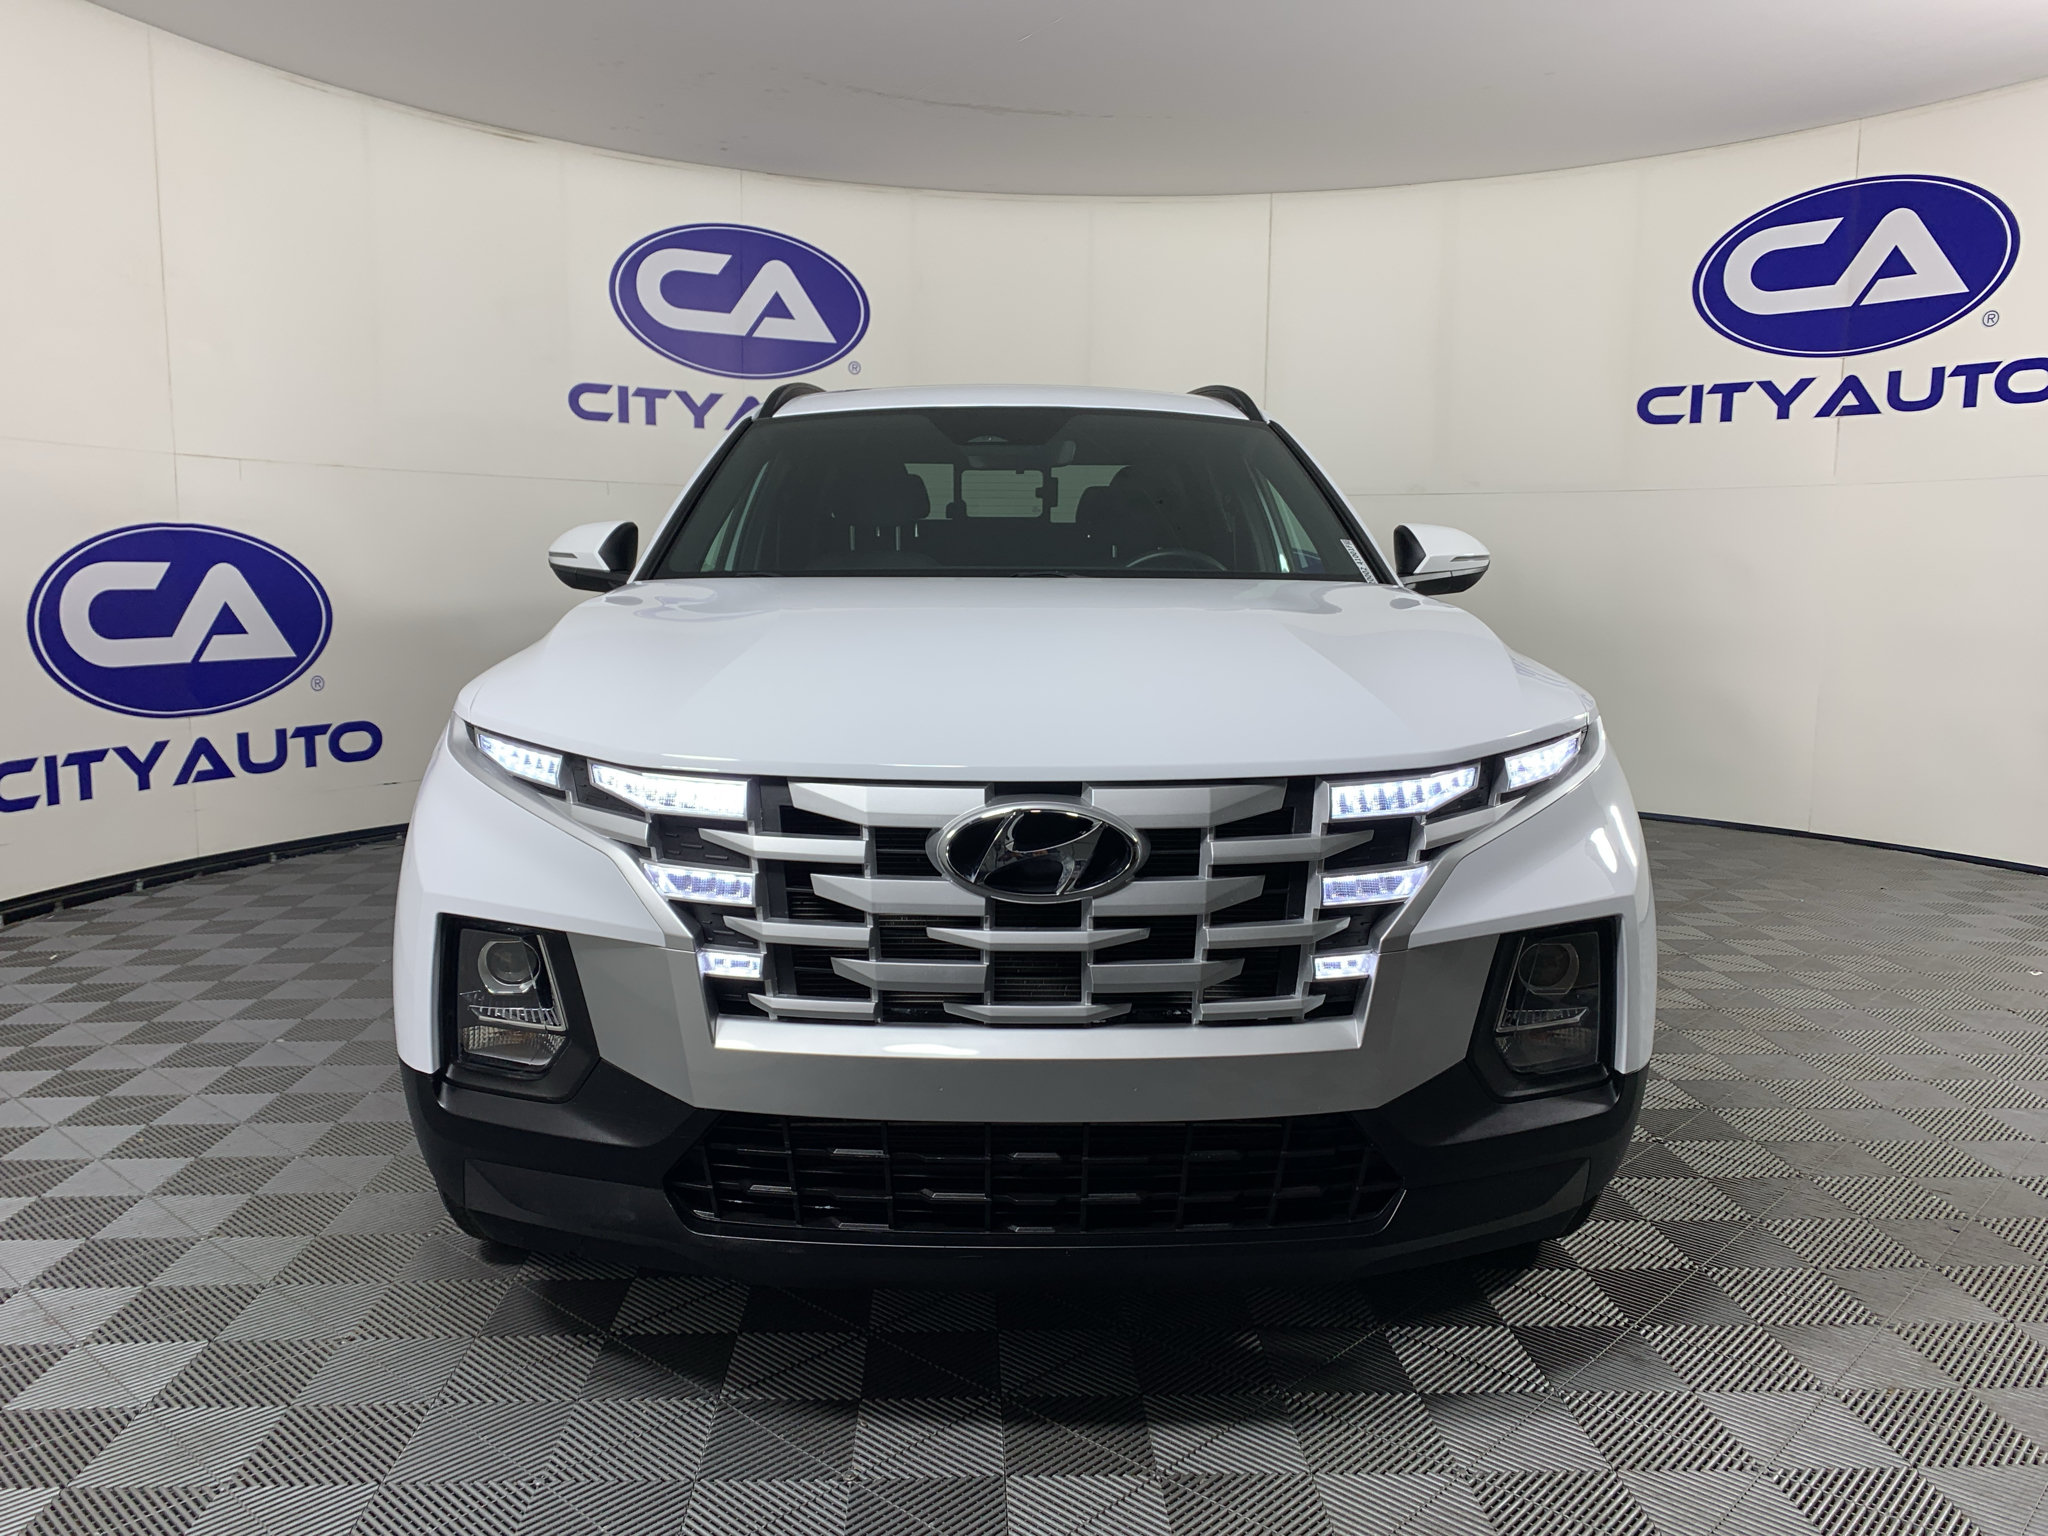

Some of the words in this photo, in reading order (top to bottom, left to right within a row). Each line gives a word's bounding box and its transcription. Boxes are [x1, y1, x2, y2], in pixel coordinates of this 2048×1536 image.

[636, 247, 838, 344] CA
[1723, 207, 1970, 315] CA
[568, 382, 724, 429] CITY
[1636, 376, 1817, 425] CITY
[59, 561, 297, 668] CA
[172, 720, 383, 786] AUTO
